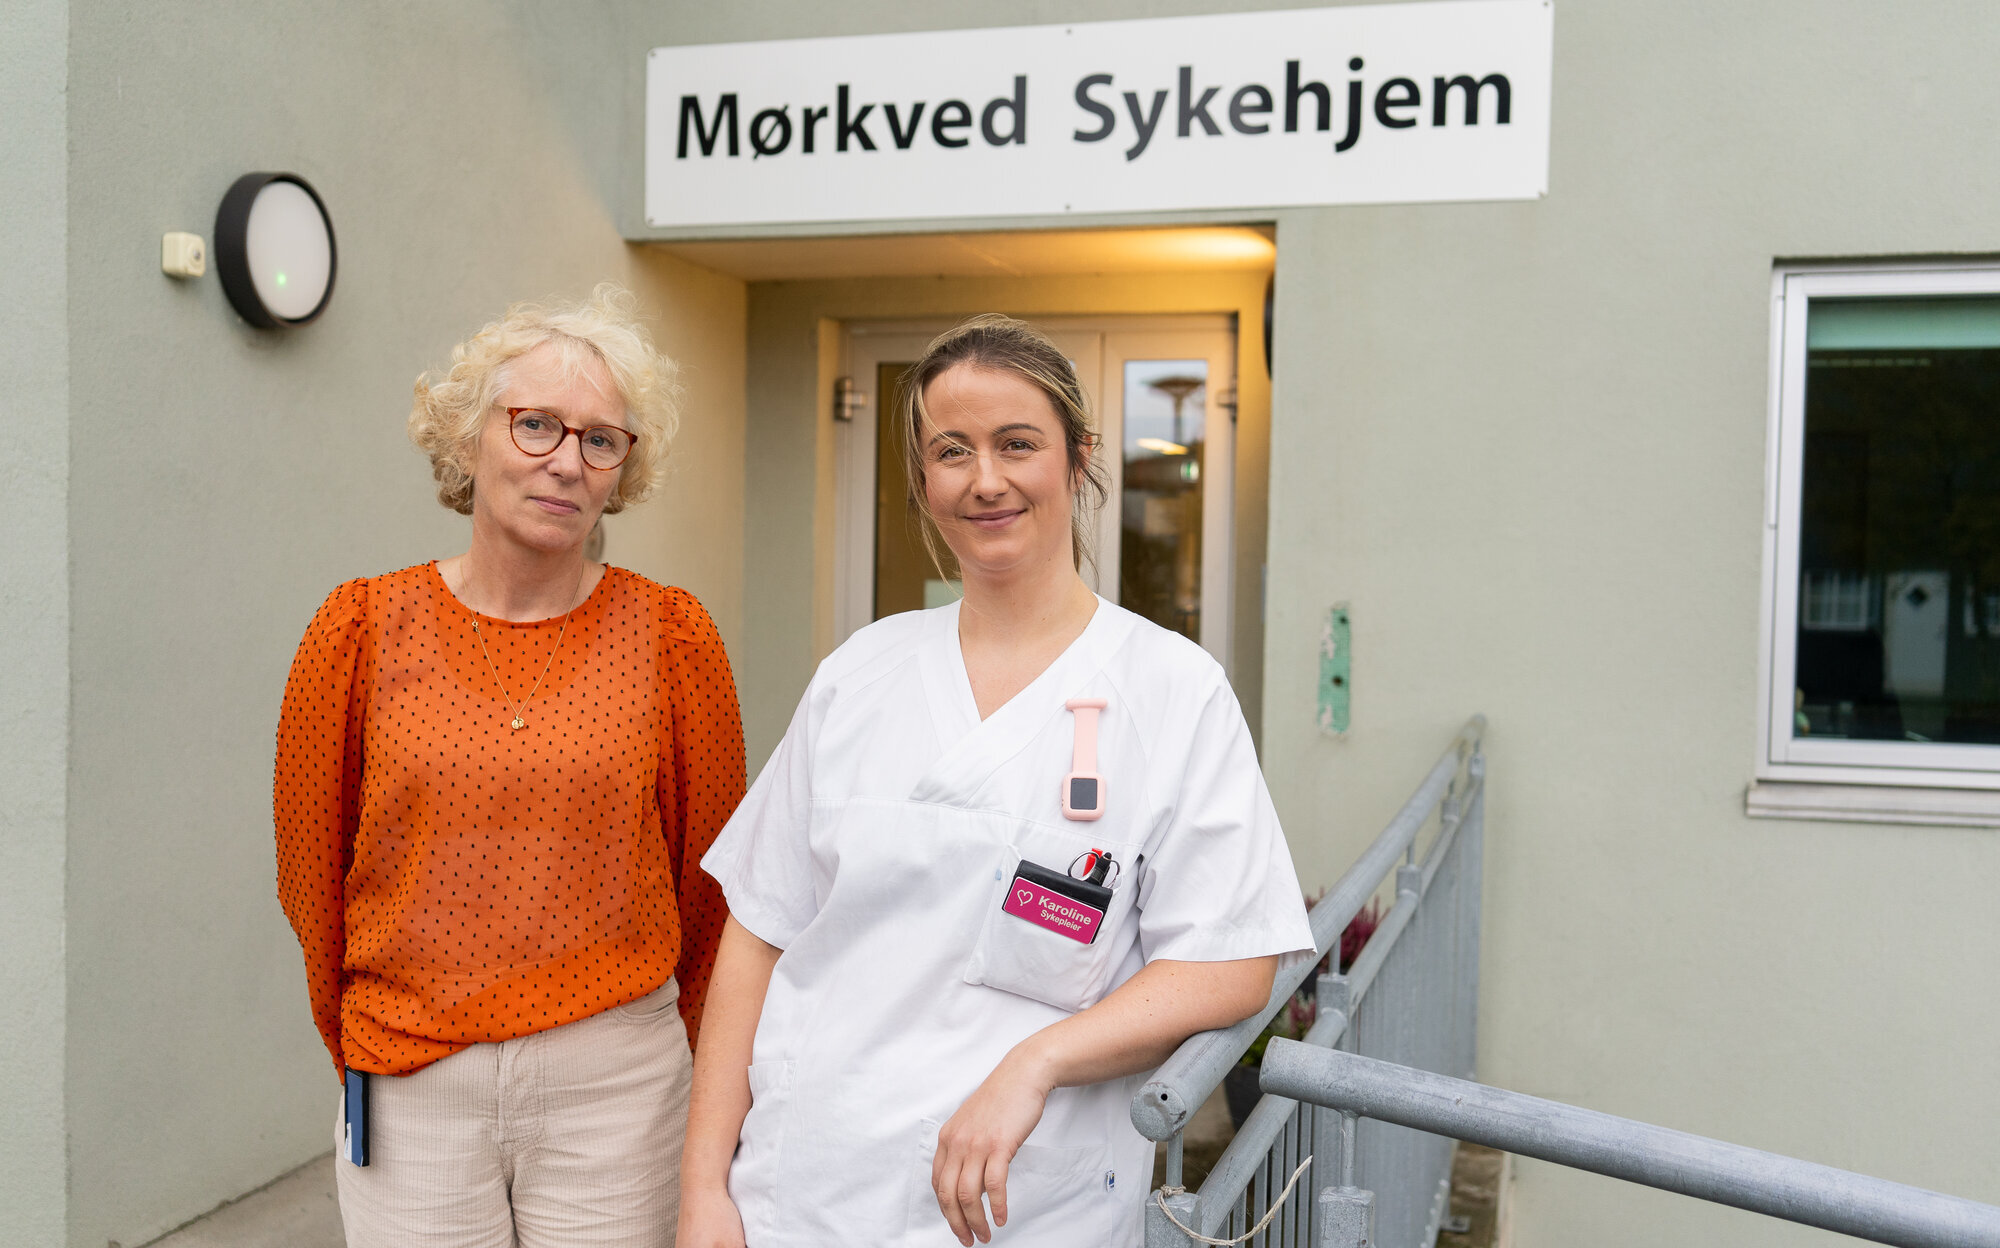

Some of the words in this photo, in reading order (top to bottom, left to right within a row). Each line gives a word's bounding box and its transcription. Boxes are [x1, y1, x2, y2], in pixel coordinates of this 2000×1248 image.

[676, 74, 1028, 159] Mørkved
[1072, 56, 1512, 161] Sykehjem
[1038, 895, 1092, 925] Karoline
[1040, 909, 1082, 932] Sykepleier
